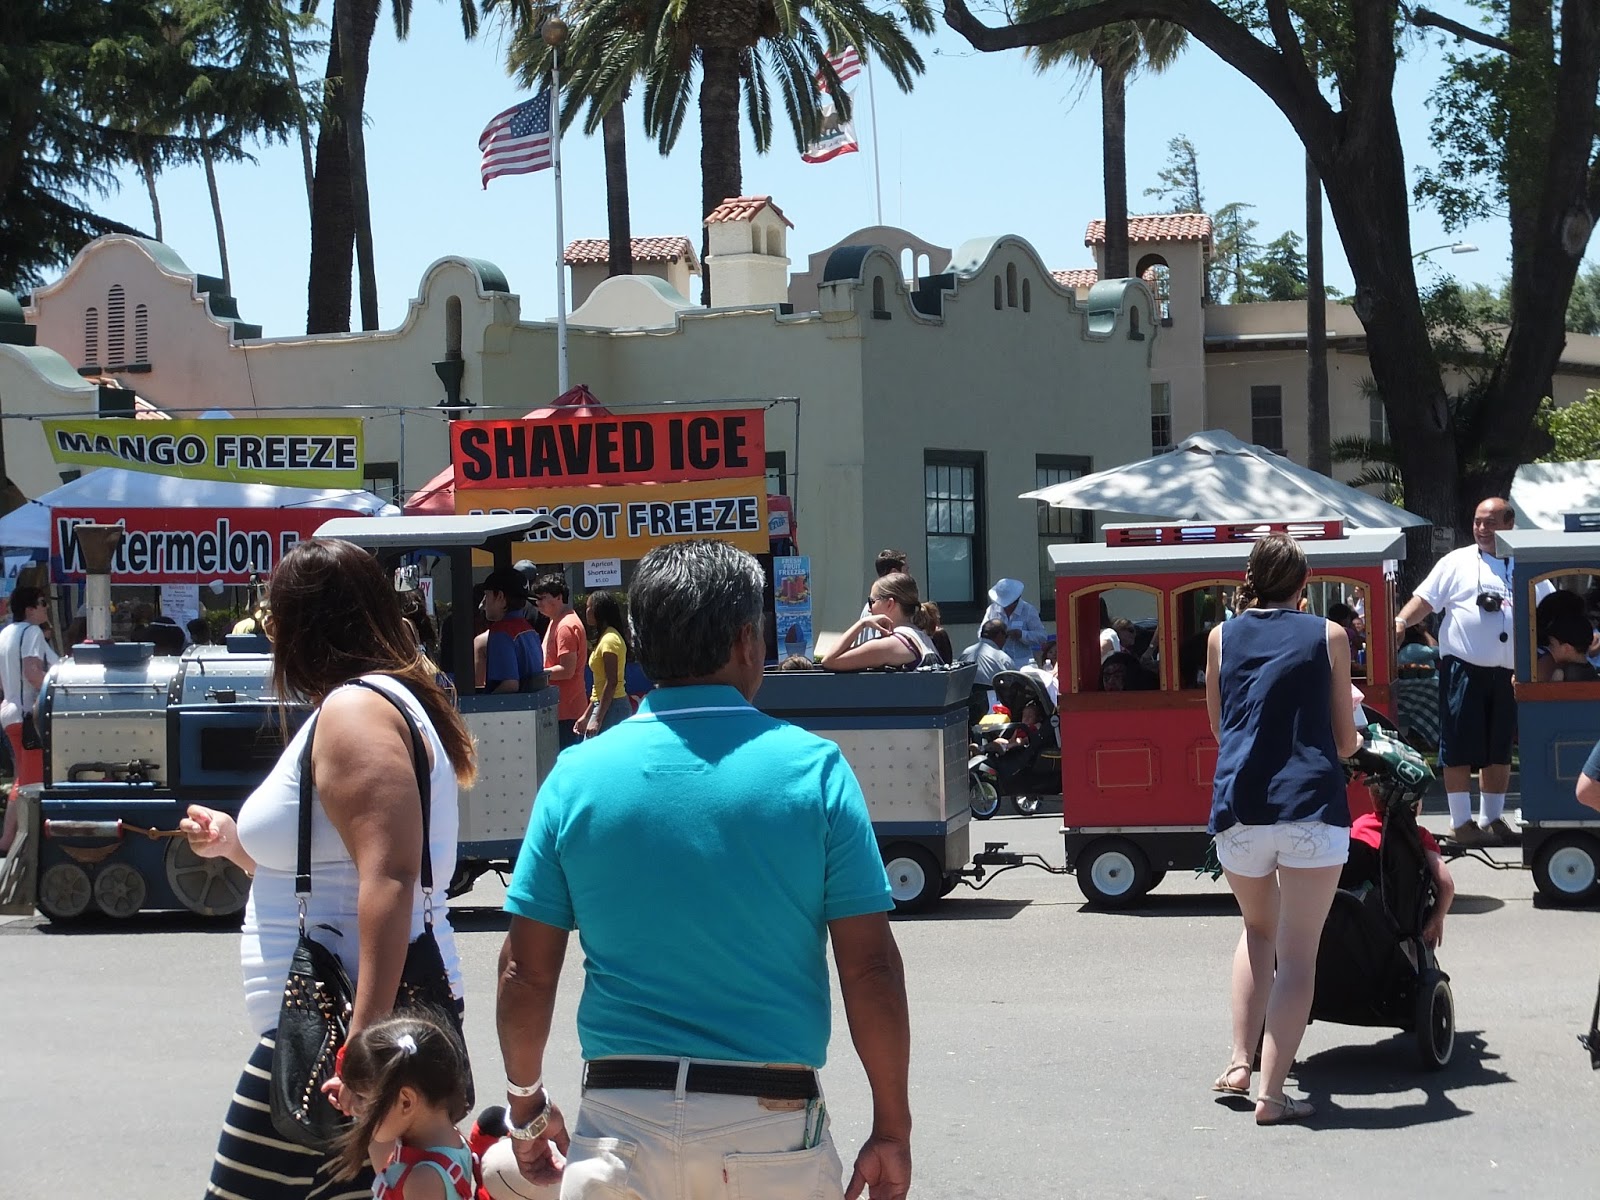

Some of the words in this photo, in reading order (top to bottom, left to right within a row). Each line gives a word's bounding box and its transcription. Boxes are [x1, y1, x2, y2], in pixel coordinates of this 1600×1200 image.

[56, 430, 208, 466] MANGO
[215, 434, 358, 470] FREEZE
[459, 420, 654, 481] SHAVED
[668, 416, 748, 471] ICE
[626, 496, 759, 538] FREEZE
[57, 517, 273, 574] Wtermelon
